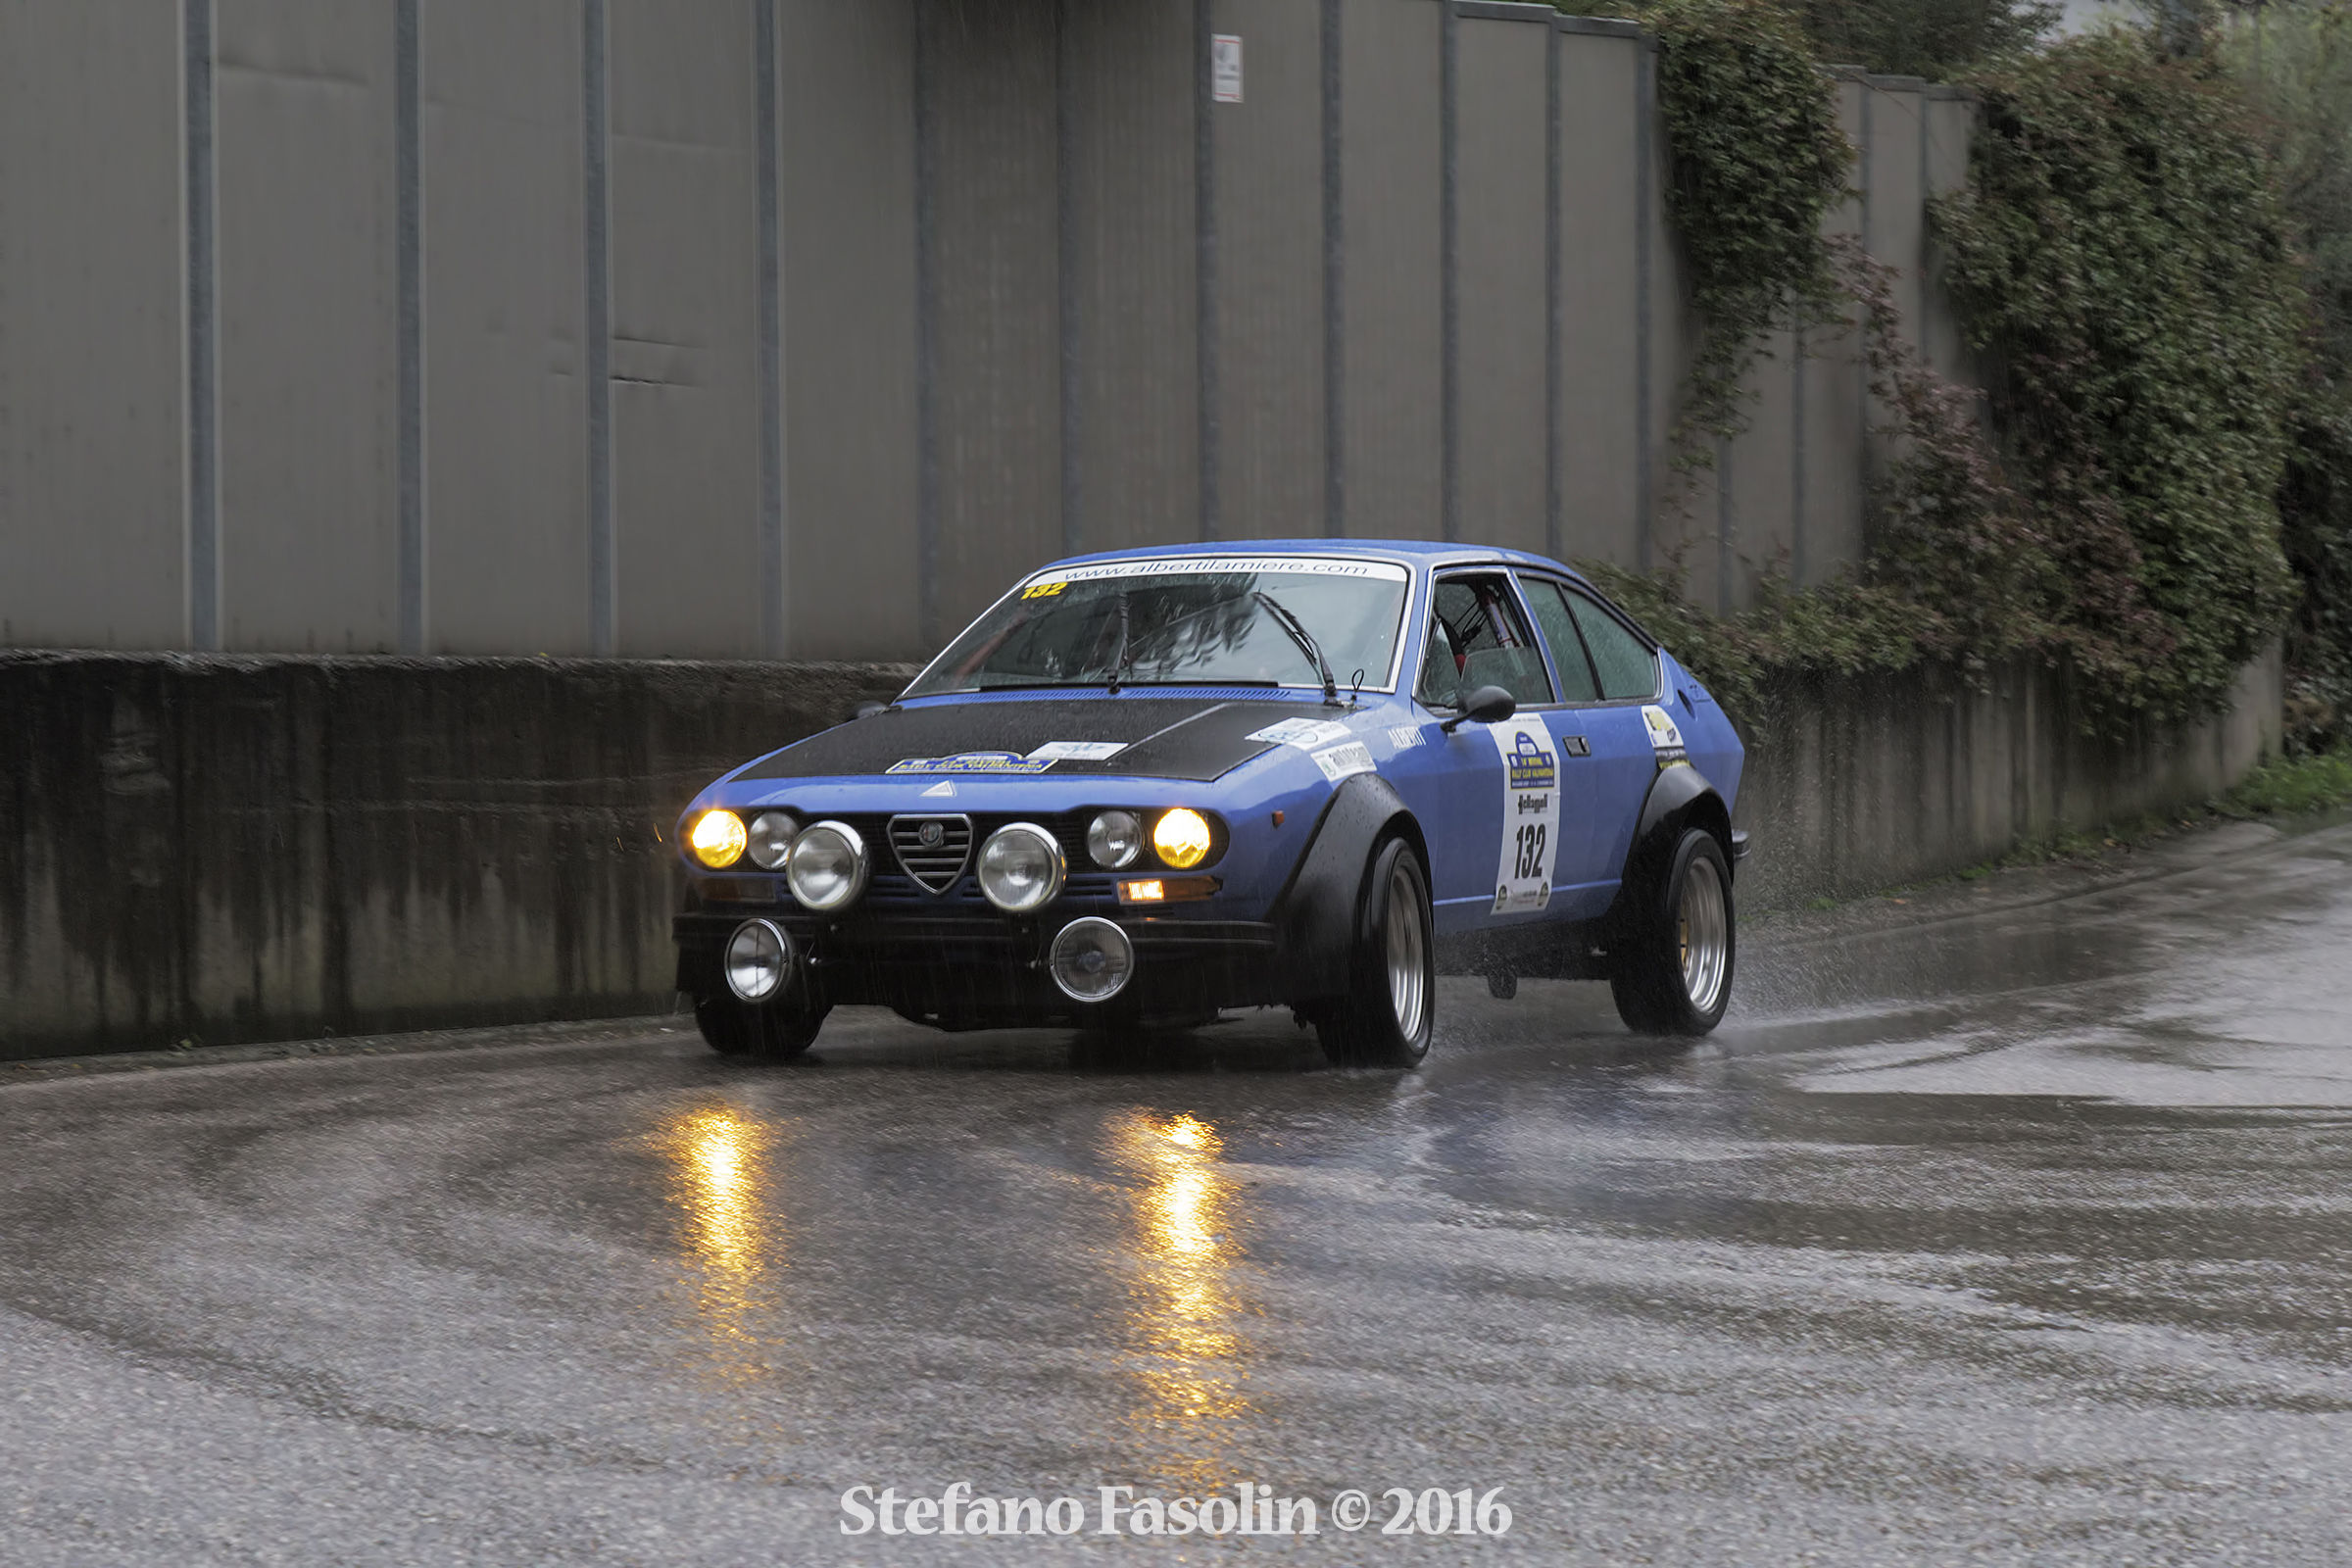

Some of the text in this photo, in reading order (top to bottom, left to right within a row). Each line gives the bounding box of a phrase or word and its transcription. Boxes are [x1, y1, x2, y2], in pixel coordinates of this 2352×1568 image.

[1065, 560, 1368, 580] www.albertilamiere.com
[1020, 582, 1068, 600] 132
[1514, 823, 1546, 879] 132
